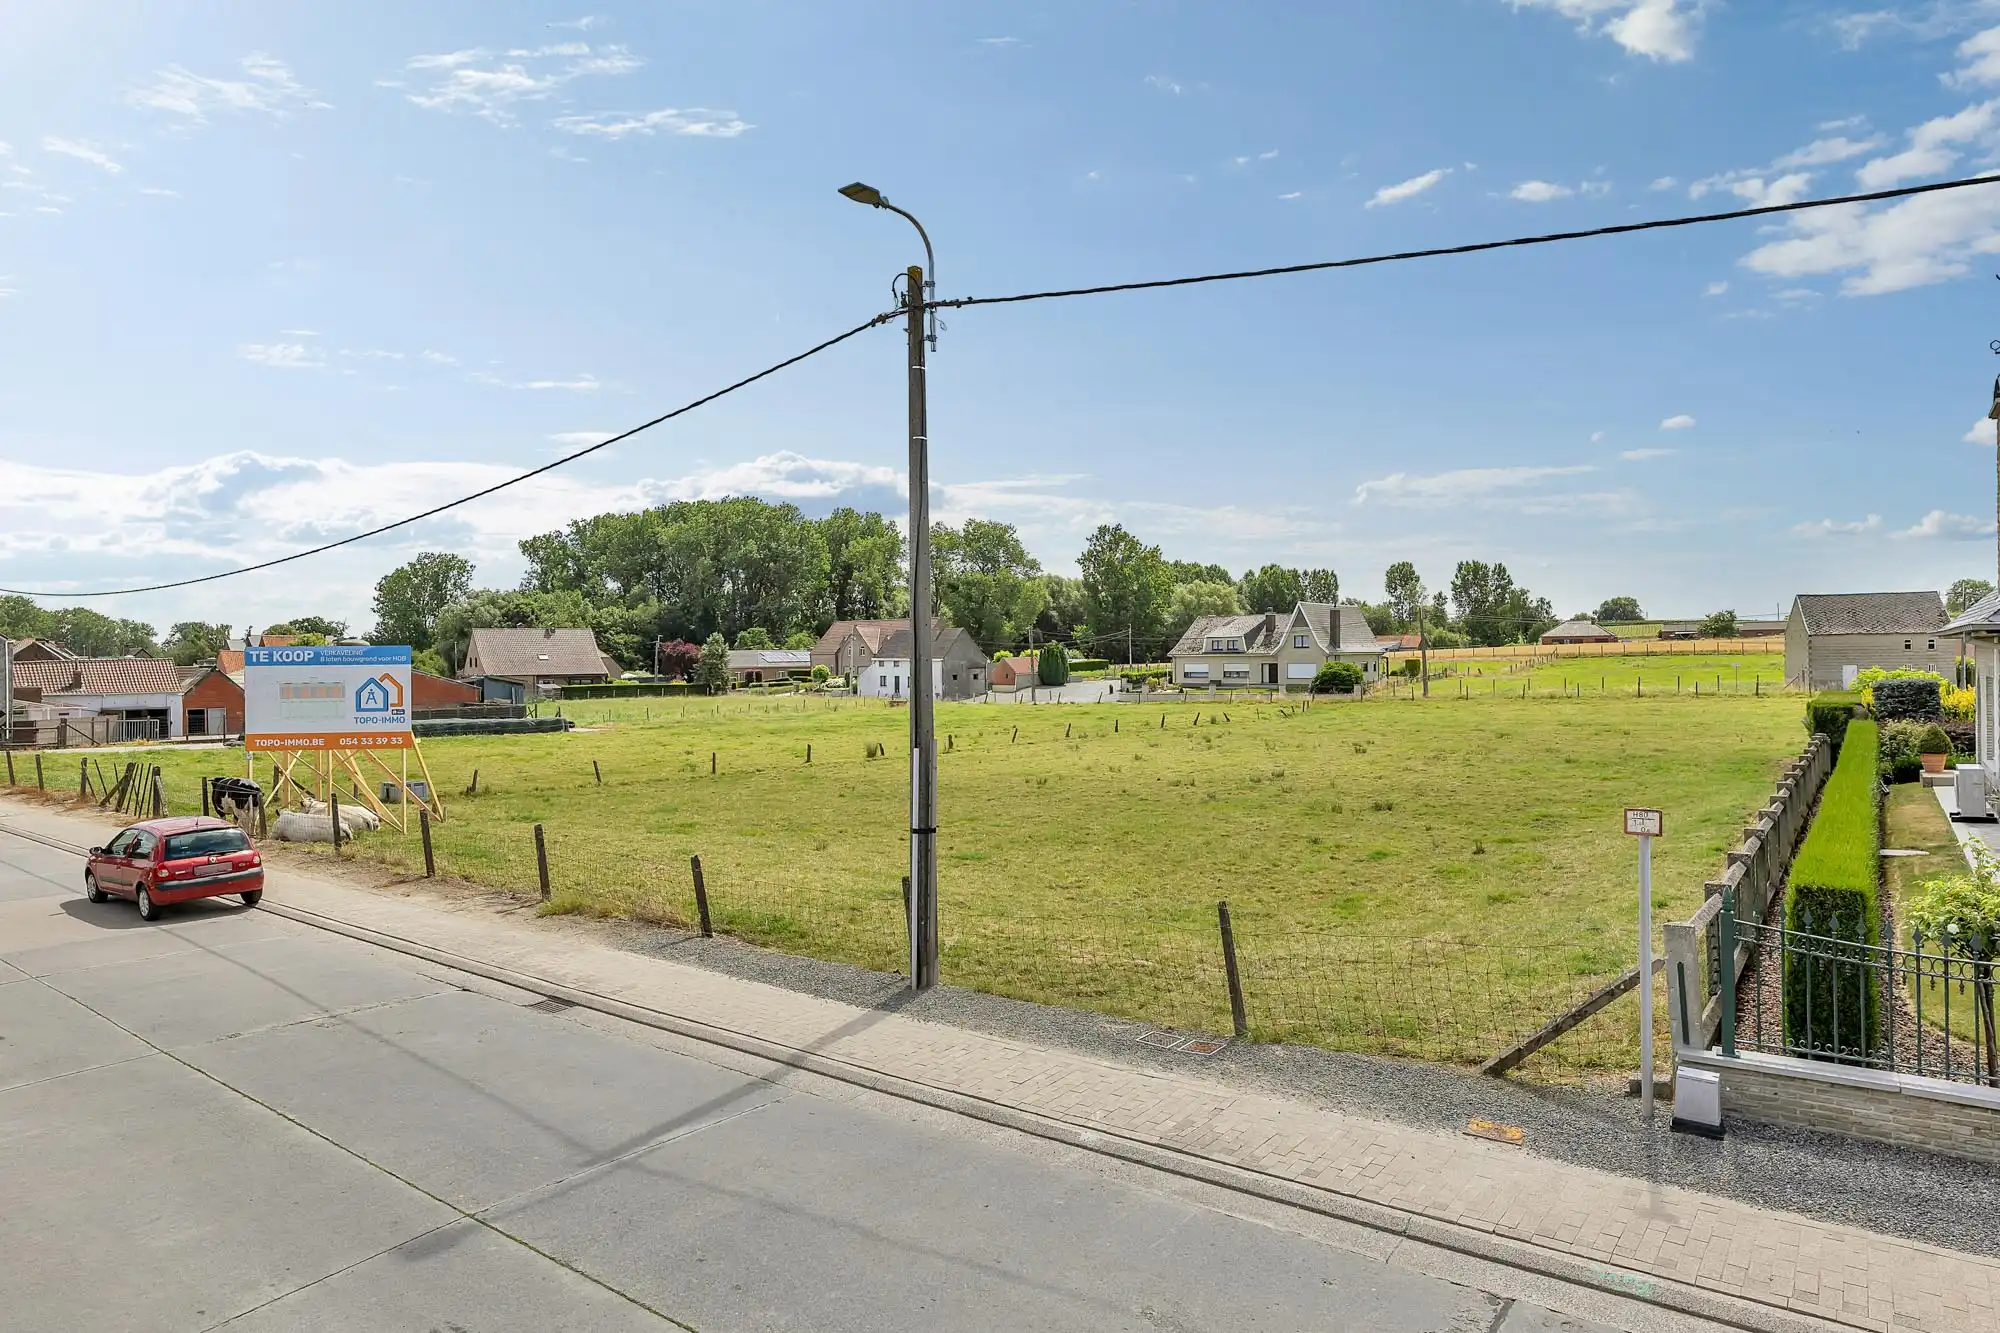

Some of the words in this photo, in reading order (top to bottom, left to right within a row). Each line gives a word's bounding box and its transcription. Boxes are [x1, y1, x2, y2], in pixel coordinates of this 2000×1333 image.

[250, 650, 269, 662] TE
[272, 650, 314, 662] KOOP
[353, 716, 406, 725] TOPO-IMMO
[254, 738, 325, 747] TOPO-IMMO.BE
[339, 737, 358, 746] 054
[361, 737, 373, 745] 33
[375, 737, 388, 745] 39
[390, 737, 403, 745] 33
